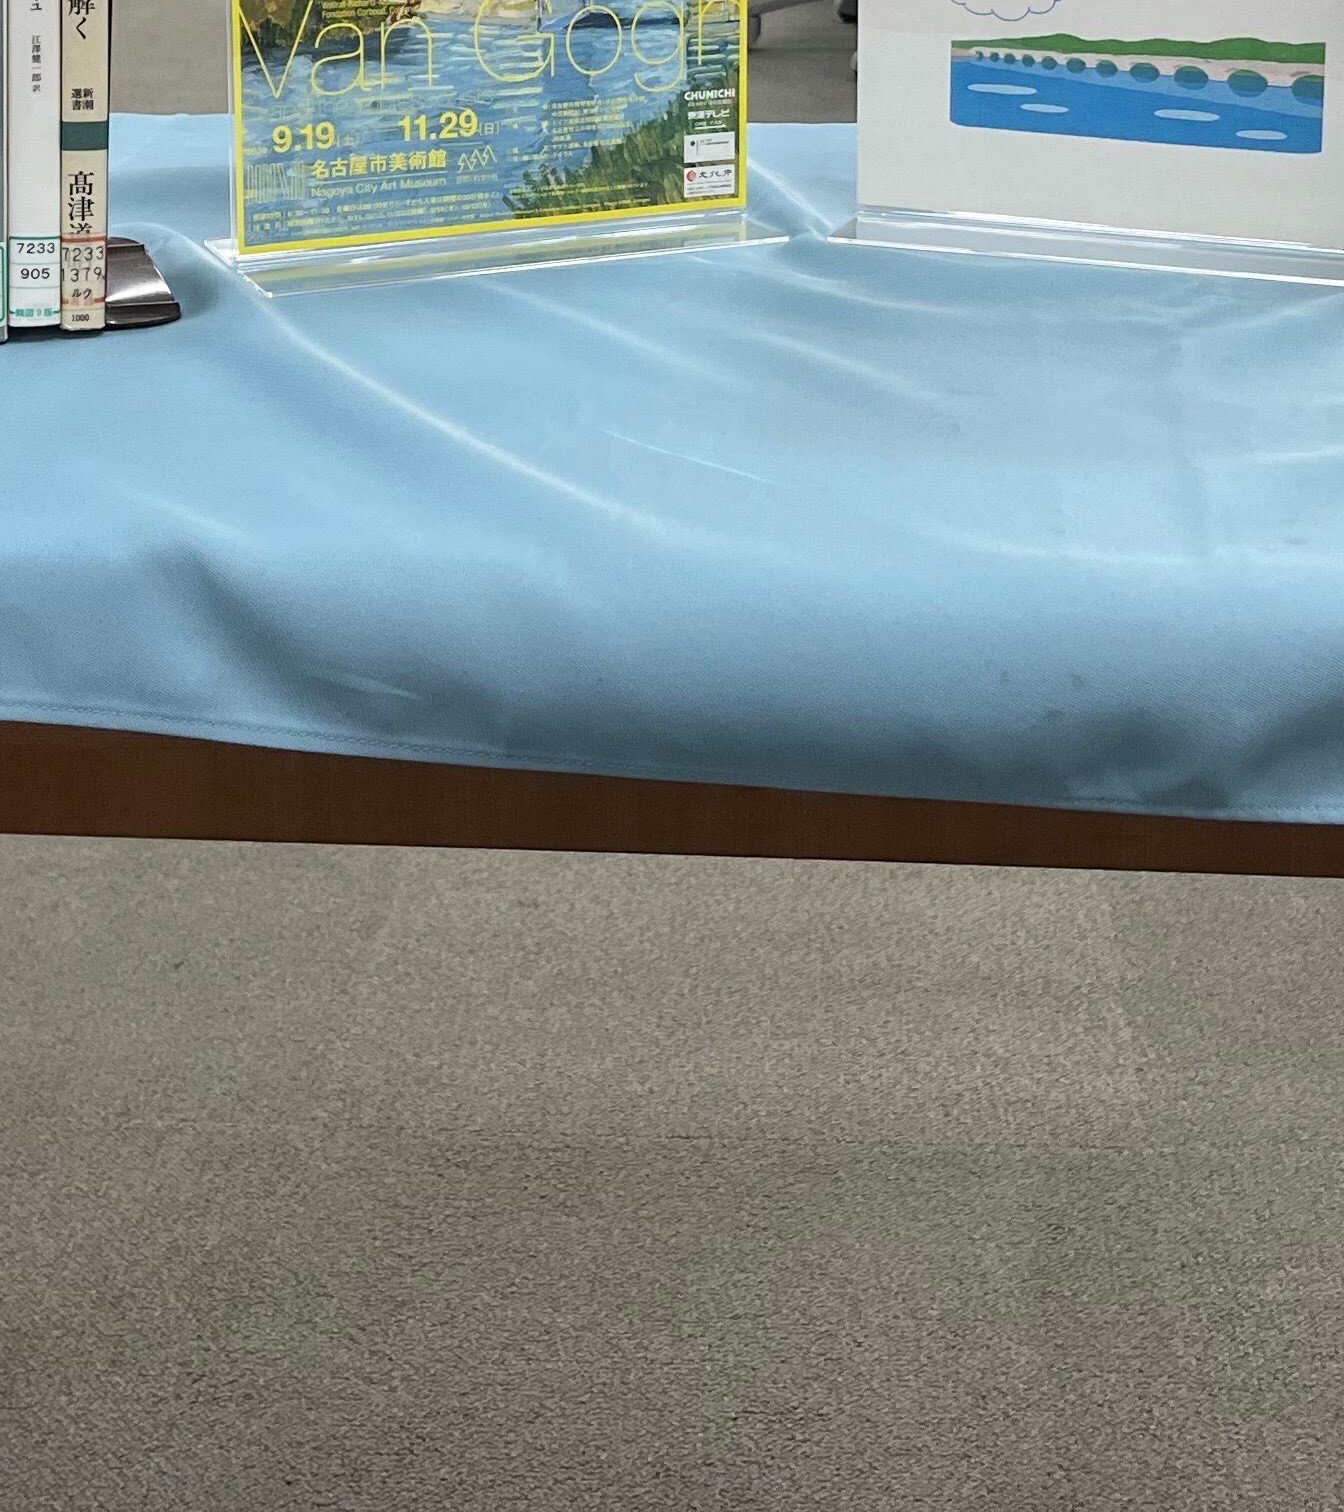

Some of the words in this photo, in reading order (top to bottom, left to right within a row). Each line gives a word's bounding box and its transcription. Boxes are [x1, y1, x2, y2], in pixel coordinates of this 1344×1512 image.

[239, 0, 435, 99] Van
[683, 88, 736, 101] CHUNICHI
[272, 121, 337, 153] 9.19
[399, 108, 479, 142] 11.29
[311, 149, 448, 180] 名古屋市美術館
[311, 186, 354, 198] Nagoya
[355, 183, 378, 194] City
[380, 181, 397, 190] Art
[399, 177, 447, 189] Museum
[17, 243, 56, 254] 7233
[63, 246, 105, 261] 7233
[20, 268, 51, 279] 905
